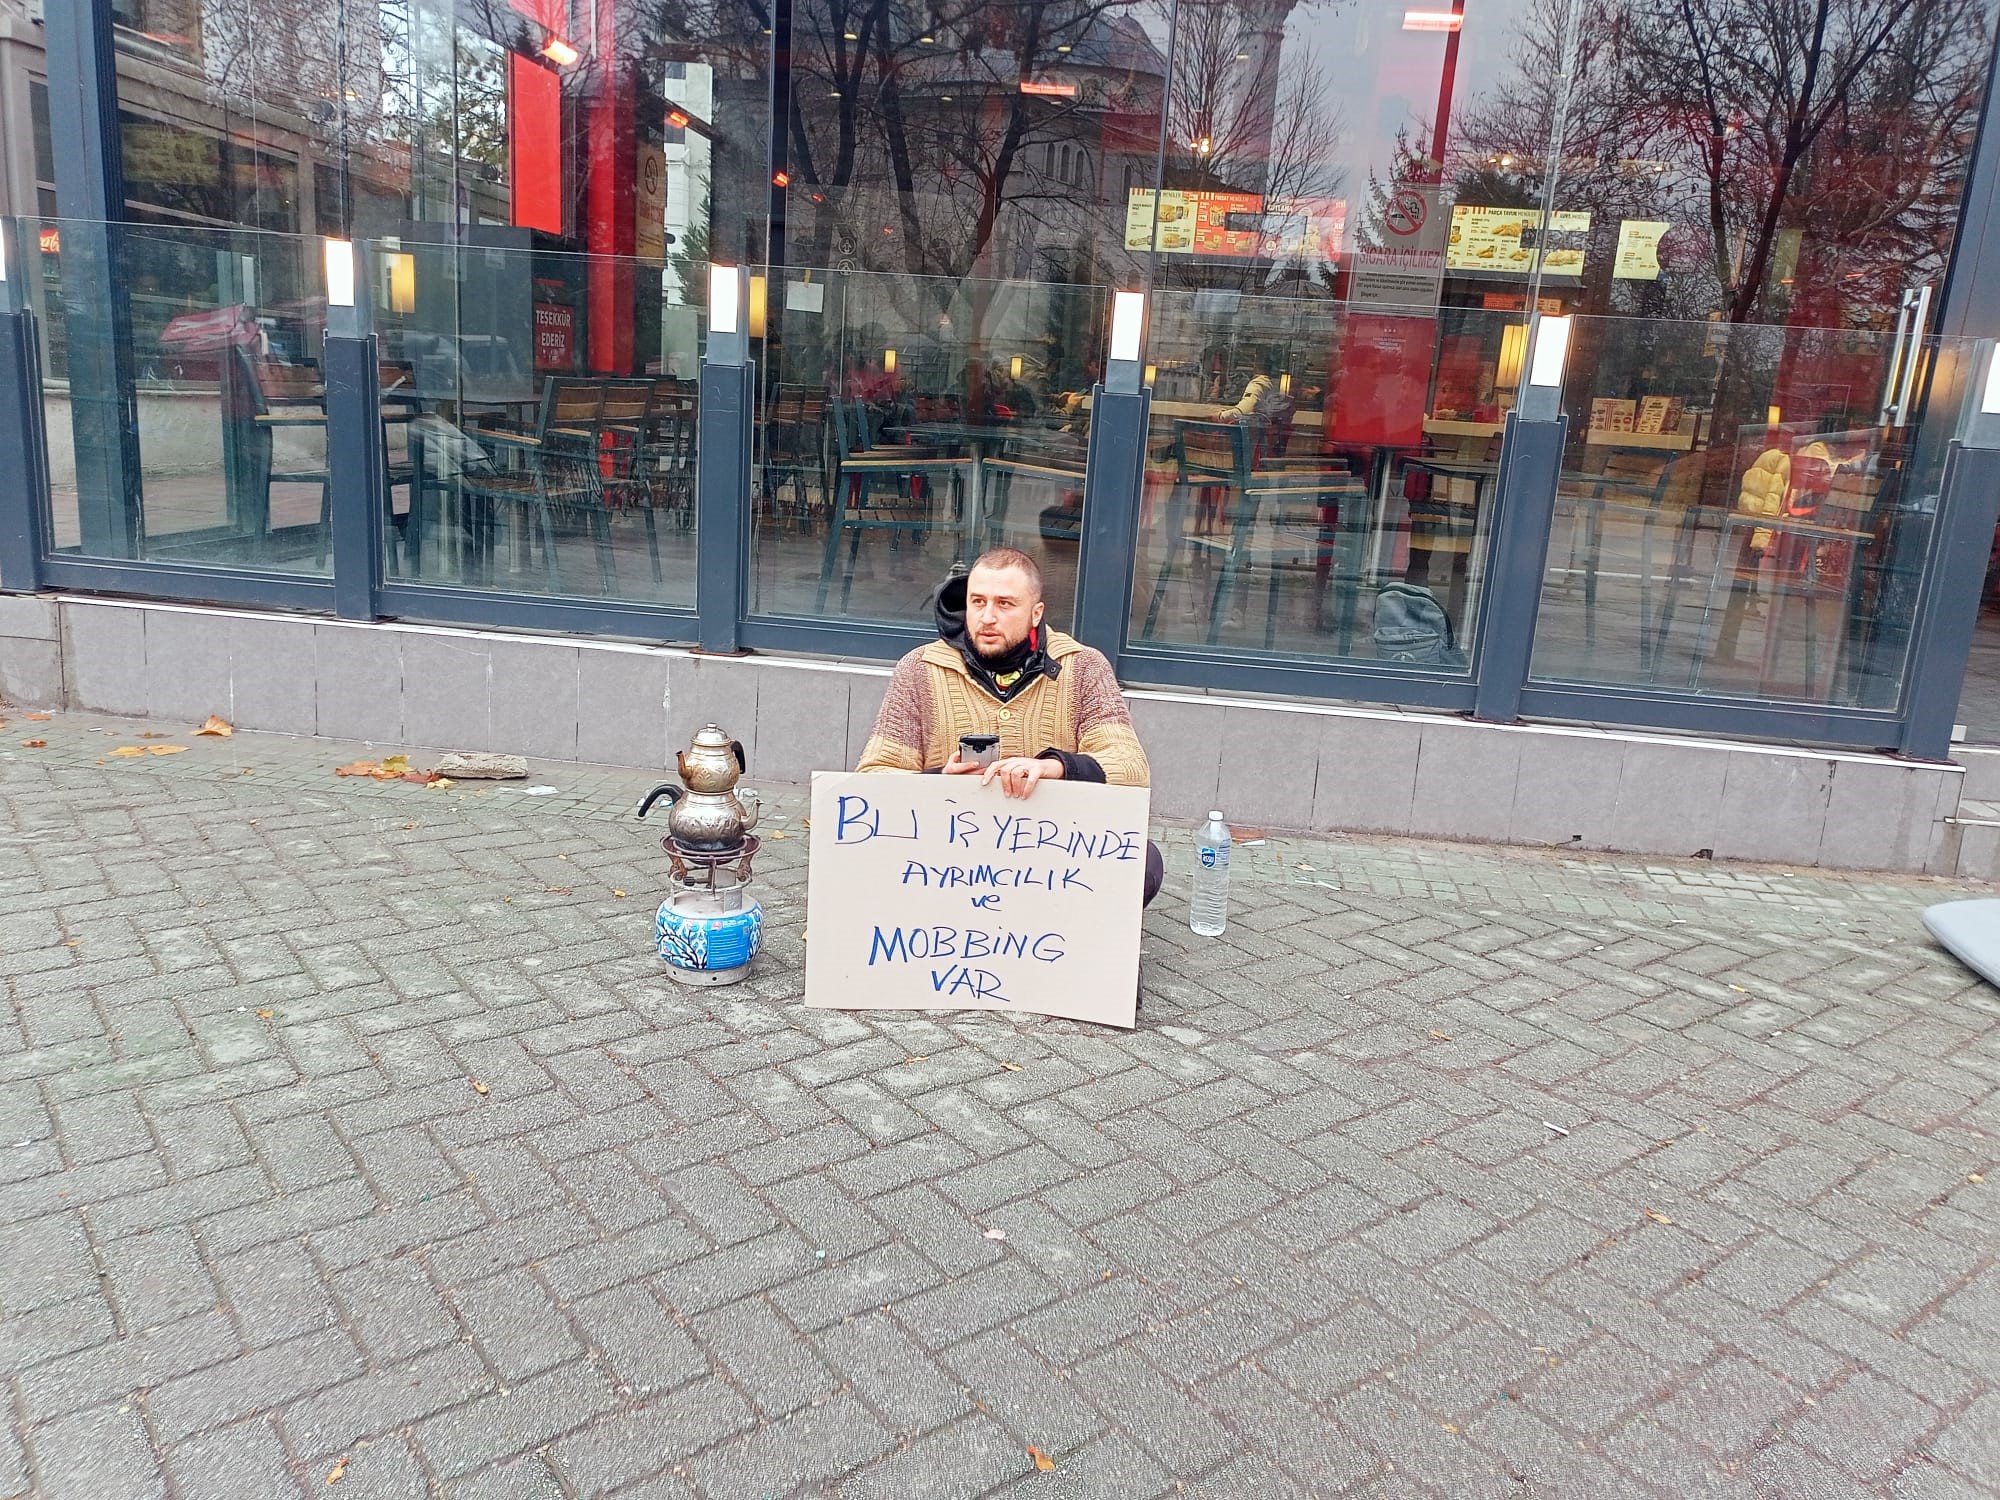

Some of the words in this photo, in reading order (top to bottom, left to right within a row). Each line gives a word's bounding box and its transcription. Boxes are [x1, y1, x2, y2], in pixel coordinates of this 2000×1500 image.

[536, 310, 571, 328] TEŞEKKÜR
[541, 330, 565, 348] EDERİZ
[945, 799, 980, 848] İŞ
[993, 815, 1141, 860] YERİNDE
[902, 860, 1094, 892] AYRIMCILIK
[971, 894, 1002, 911] ve
[868, 926, 1066, 966] MOBBİNG
[931, 964, 1010, 1002] VAR
